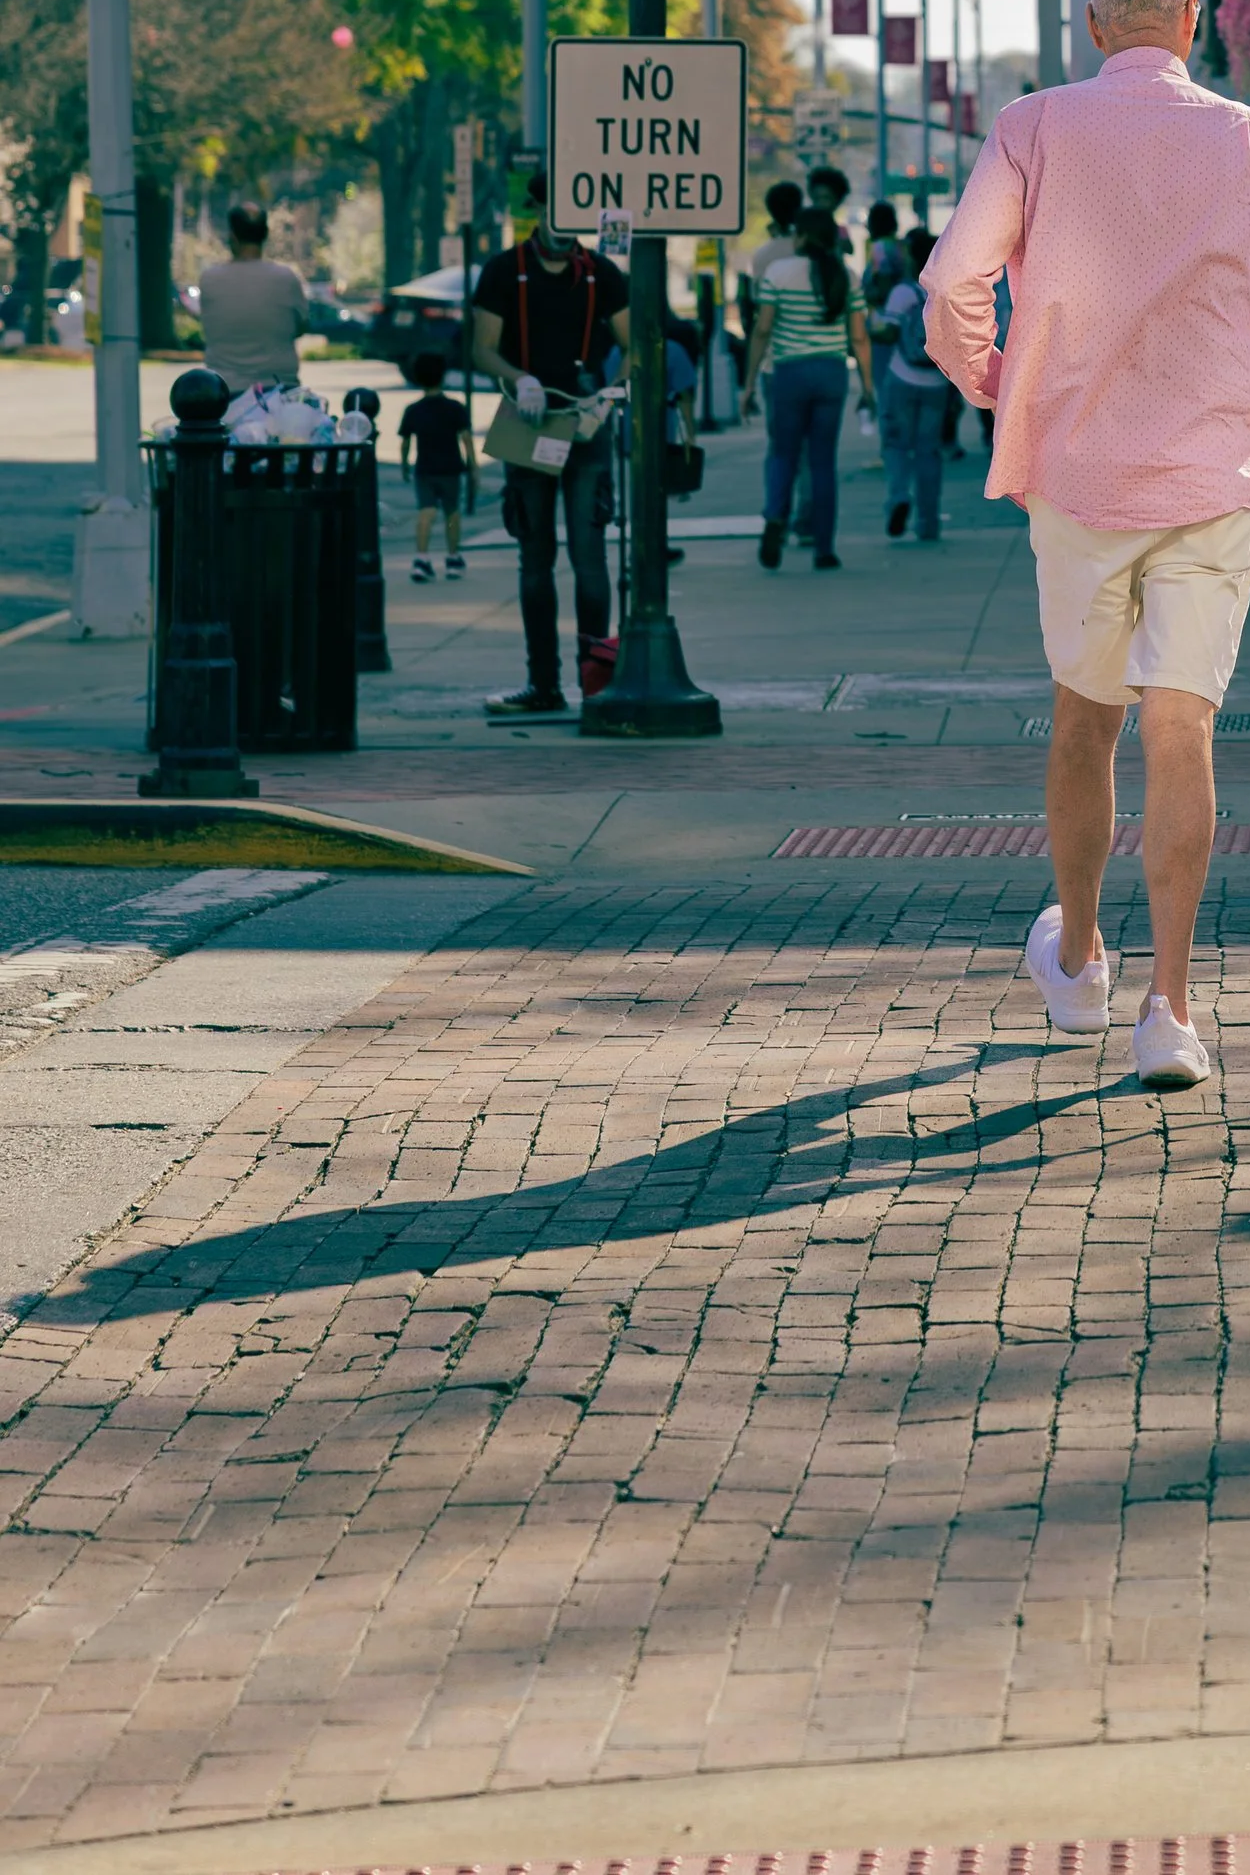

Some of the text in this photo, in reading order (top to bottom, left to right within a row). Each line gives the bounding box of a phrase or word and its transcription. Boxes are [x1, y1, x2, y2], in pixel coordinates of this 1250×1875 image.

[622, 64, 674, 102] NO
[596, 118, 700, 155] TURN
[797, 123, 840, 147] 25
[572, 172, 723, 210] ON RED
